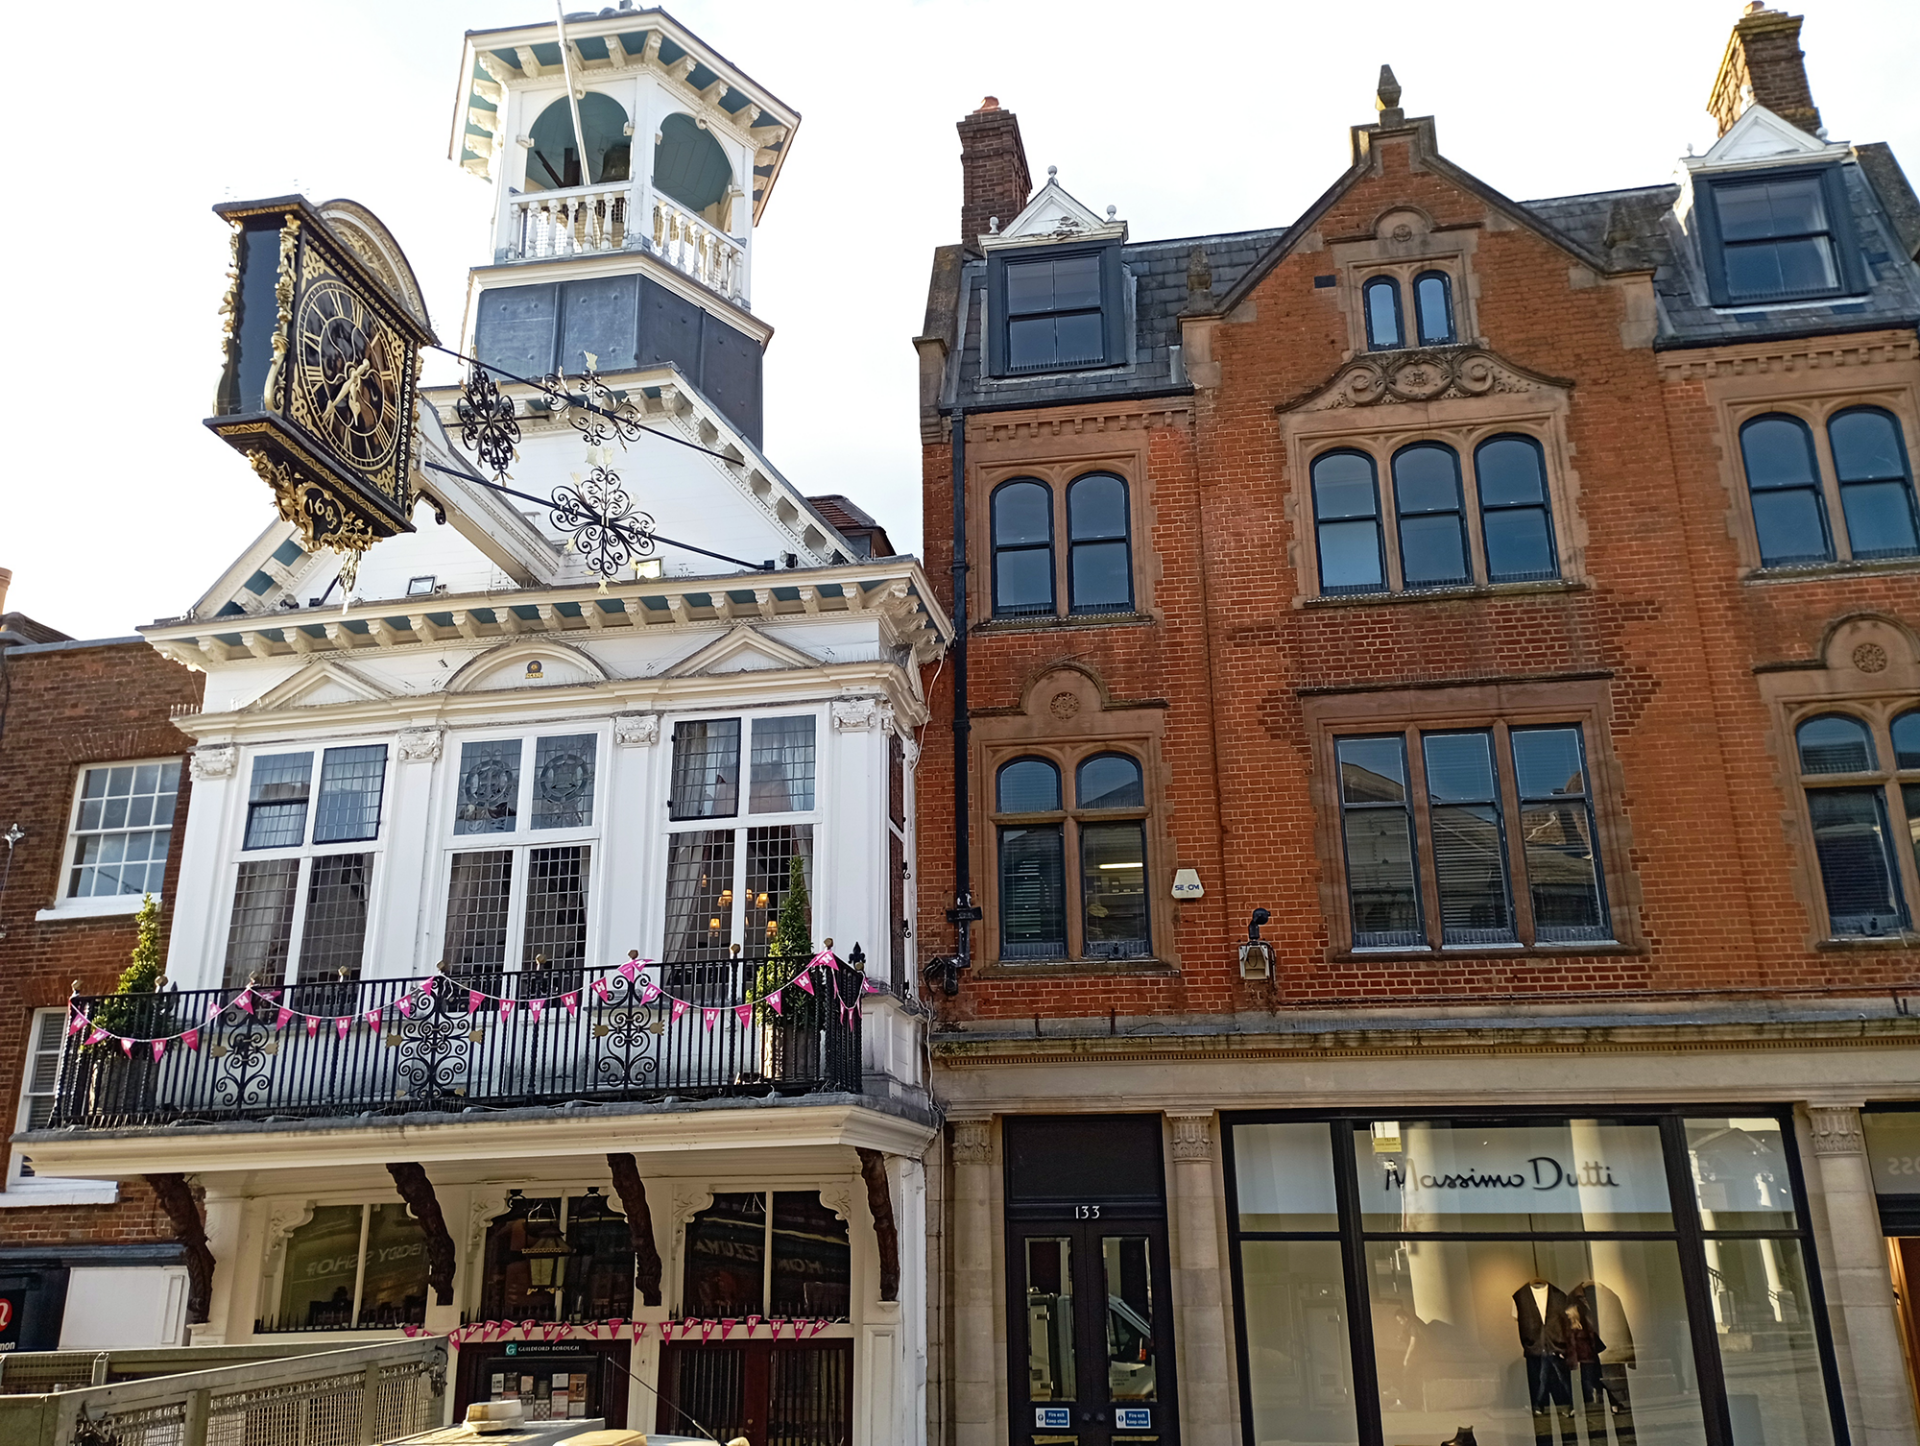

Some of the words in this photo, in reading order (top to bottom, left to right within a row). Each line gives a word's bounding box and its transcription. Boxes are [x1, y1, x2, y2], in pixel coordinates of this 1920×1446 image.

[308, 497, 337, 529] 1683
[798, 975, 809, 986] H
[595, 982, 605, 993] H
[646, 986, 655, 997] H
[238, 995, 249, 1007] H
[399, 999, 409, 1009] H
[565, 995, 575, 1005] H
[769, 994, 780, 1004] H
[502, 1001, 511, 1011] H
[532, 1002, 541, 1011] H
[674, 1003, 684, 1013] H
[369, 1012, 379, 1022] H
[706, 1011, 715, 1020] H
[308, 1018, 316, 1028] H
[339, 1019, 348, 1028] H
[155, 1042, 164, 1051] H
[1386, 1158, 1525, 1191] Massimo
[1528, 1157, 1620, 1191] Dutti
[1075, 1205, 1100, 1219] 133
[485, 1323, 494, 1332] H
[524, 1322, 531, 1331] H
[685, 1319, 694, 1328] H
[703, 1323, 711, 1332] H
[748, 1318, 756, 1327] H
[772, 1322, 780, 1330] H
[795, 1322, 804, 1330] H
[815, 1320, 825, 1329] H
[634, 1324, 643, 1333] H
[663, 1324, 671, 1333] H
[449, 1332, 458, 1342] H
